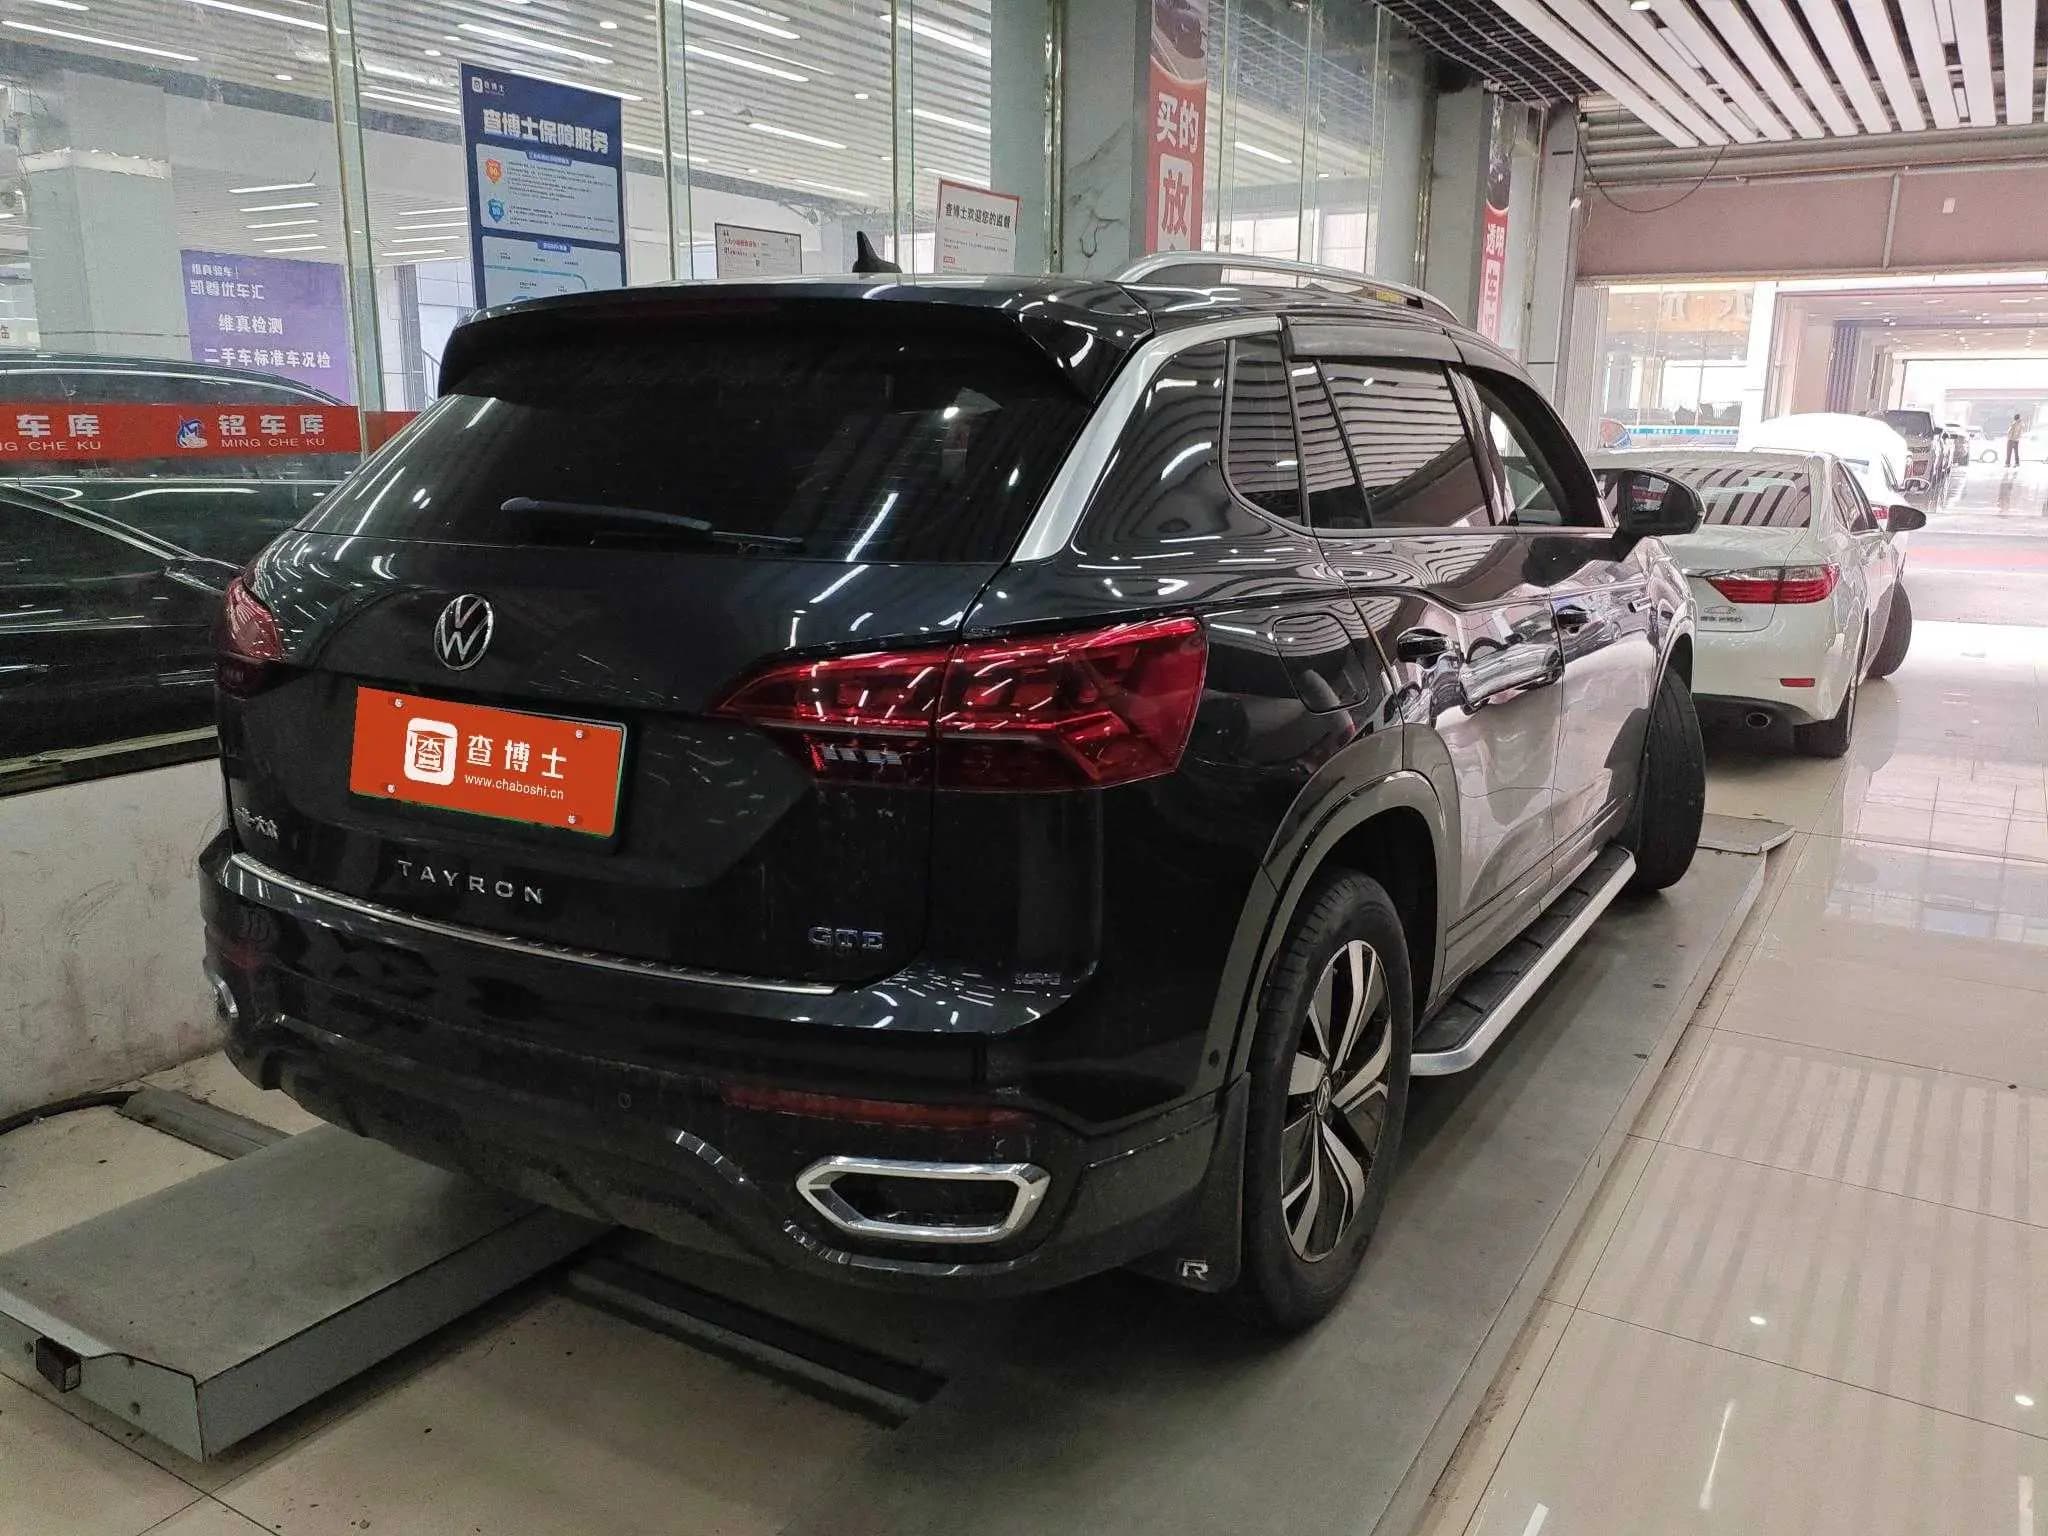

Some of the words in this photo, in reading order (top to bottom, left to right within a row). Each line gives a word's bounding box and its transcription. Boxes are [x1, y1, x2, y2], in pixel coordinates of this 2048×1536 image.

[482, 108, 609, 154] 查博士保障服务
[1156, 92, 1200, 153] 买的
[945, 202, 1011, 229] 查博士欢迎您的监督
[1161, 168, 1190, 250] 放
[1486, 223, 1505, 257] 透明
[190, 279, 265, 300] 凯尊优车汇
[218, 313, 284, 335] 维真检测
[204, 347, 332, 369] 二手车标准车况检
[218, 413, 325, 436] 铭车库
[28, 441, 65, 451] CHE
[77, 441, 100, 450] KU
[221, 438, 261, 448] MING
[268, 438, 299, 447] CHE
[305, 438, 325, 446] KU
[397, 859, 543, 905] TAYRON
[807, 926, 883, 949] GTE
[1181, 1261, 1209, 1281] R
